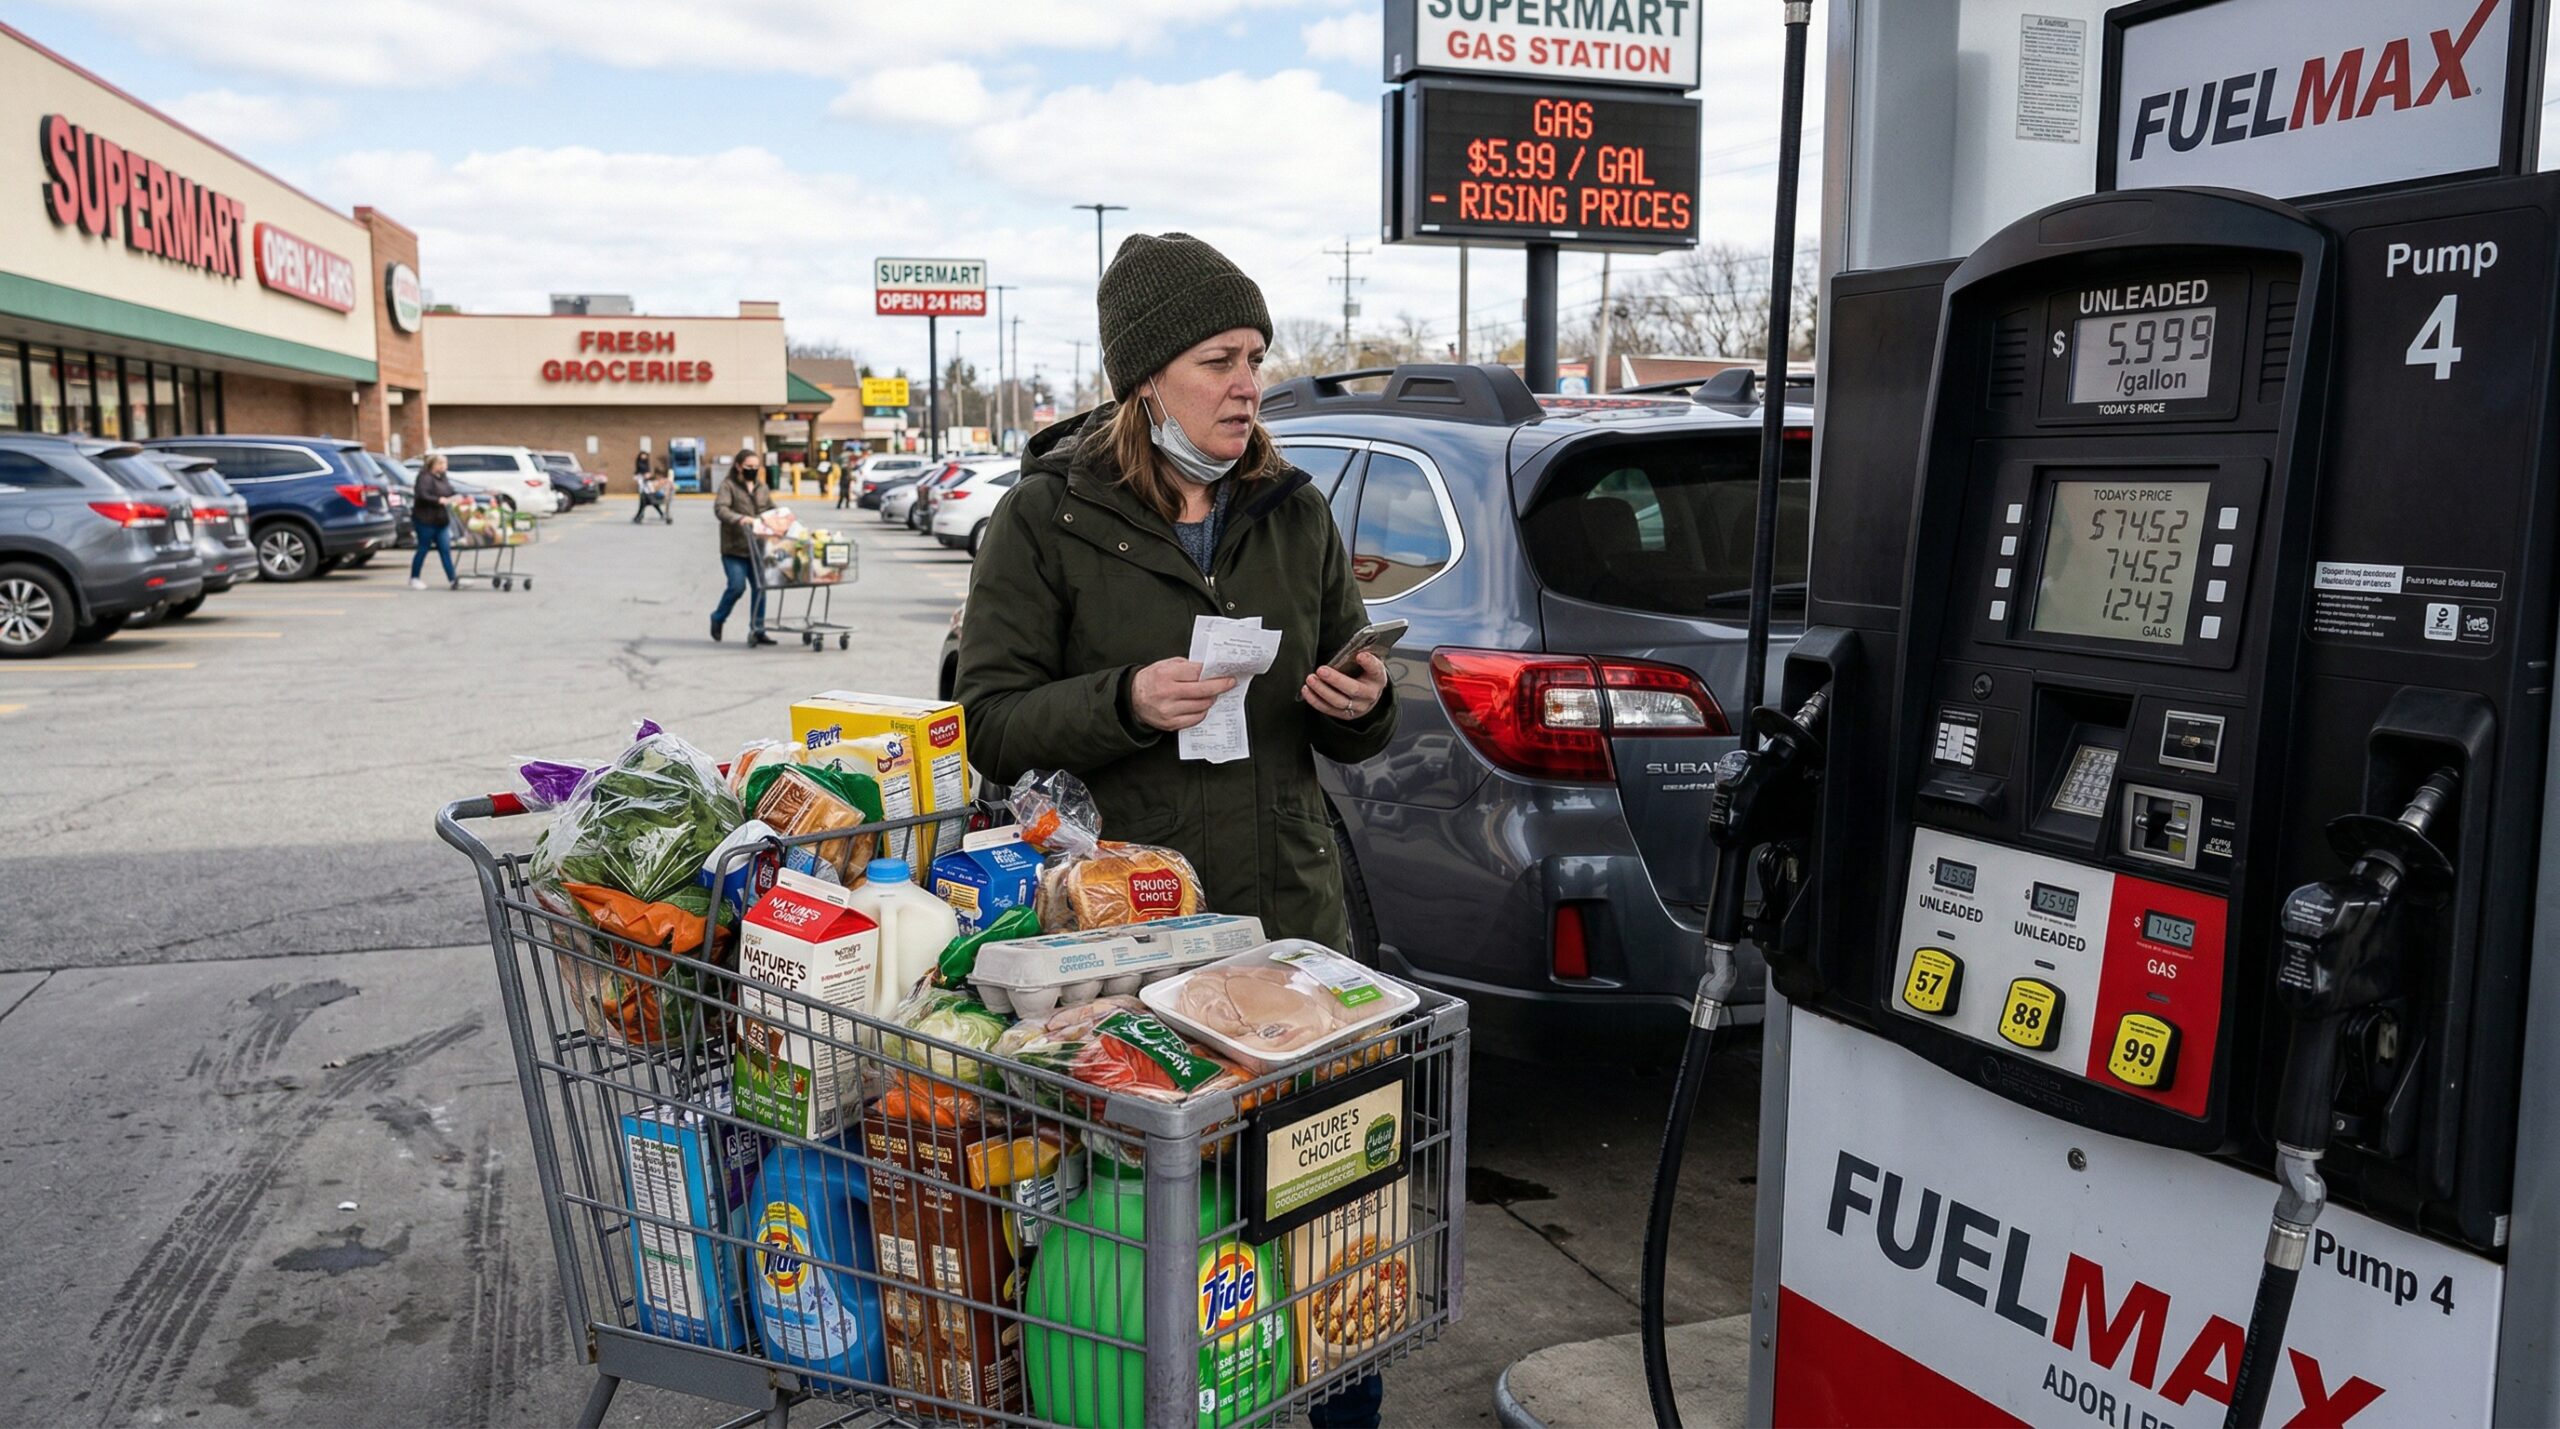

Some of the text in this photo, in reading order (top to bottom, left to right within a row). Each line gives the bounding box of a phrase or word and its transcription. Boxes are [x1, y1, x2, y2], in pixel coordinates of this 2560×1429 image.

[1447, 30, 1671, 75] GAS STATION
[2128, 0, 2501, 162] FUELMAX
[1533, 99, 1594, 140] GAS
[1466, 138, 1656, 186] $5.99 / GAL
[40, 112, 246, 282] SUPERMART
[1460, 181, 1568, 224] RISING
[1580, 188, 1691, 230] PRICES
[261, 229, 354, 311] OPEN 24 HRS
[880, 264, 980, 284] SUPERMART
[2386, 240, 2499, 279] Pump
[880, 292, 983, 311] OPEN 24 HRS
[2080, 279, 2209, 315] UNLEADED
[578, 331, 676, 353] FRESH
[2052, 314, 2213, 366] $ 5.999
[2404, 293, 2463, 381] 4
[541, 359, 715, 383] GROCERIES
[2116, 368, 2187, 397] /gallon
[2137, 402, 2166, 414] PRICE
[2139, 489, 2172, 502] PRICE
[2106, 548, 2182, 584] 74.52
[2101, 588, 2174, 624] 12.43
[2142, 625, 2172, 639] GALS
[1646, 761, 1720, 774] SUBA
[1919, 894, 1984, 923] UNLEADED
[2014, 920, 2087, 952] UNLEADED
[743, 946, 807, 981] NATURE'S
[749, 965, 799, 991] CHOICE
[2147, 958, 2177, 979] GAS
[1914, 970, 1944, 996] 57
[2012, 1002, 2043, 1030] 88
[2122, 1038, 2156, 1068] 99
[1291, 1107, 1360, 1150] NATURE'S
[1298, 1131, 1352, 1168] CHOICE
[1826, 1149, 2387, 1429] FUELMAX
[2313, 1227, 2456, 1316] Pump 4
